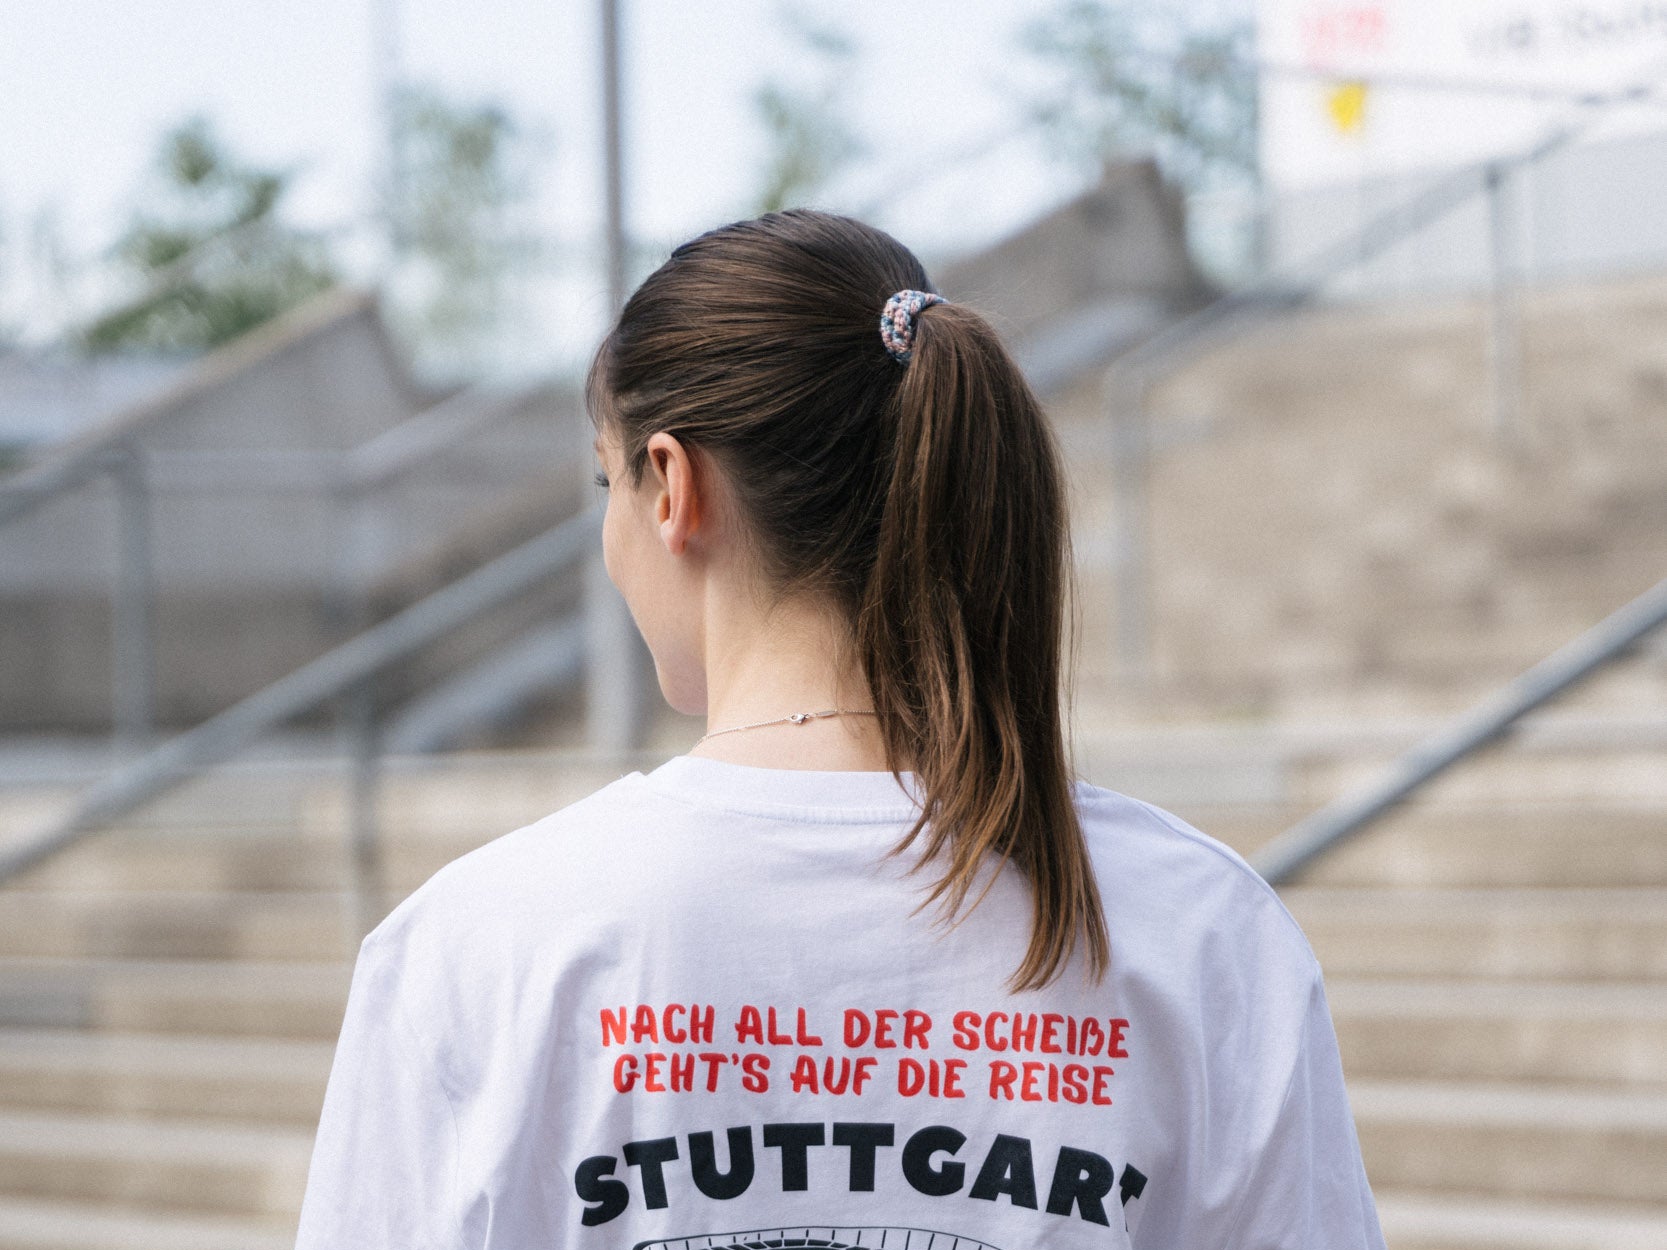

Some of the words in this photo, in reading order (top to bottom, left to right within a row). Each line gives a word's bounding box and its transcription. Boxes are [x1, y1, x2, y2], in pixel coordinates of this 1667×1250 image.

[599, 1003, 715, 1048] NACH
[734, 1005, 823, 1047] ALL
[843, 1008, 933, 1050] DER
[790, 1054, 878, 1096] AUF
[897, 1057, 968, 1099] DIE
[989, 1060, 1114, 1106] REISE
